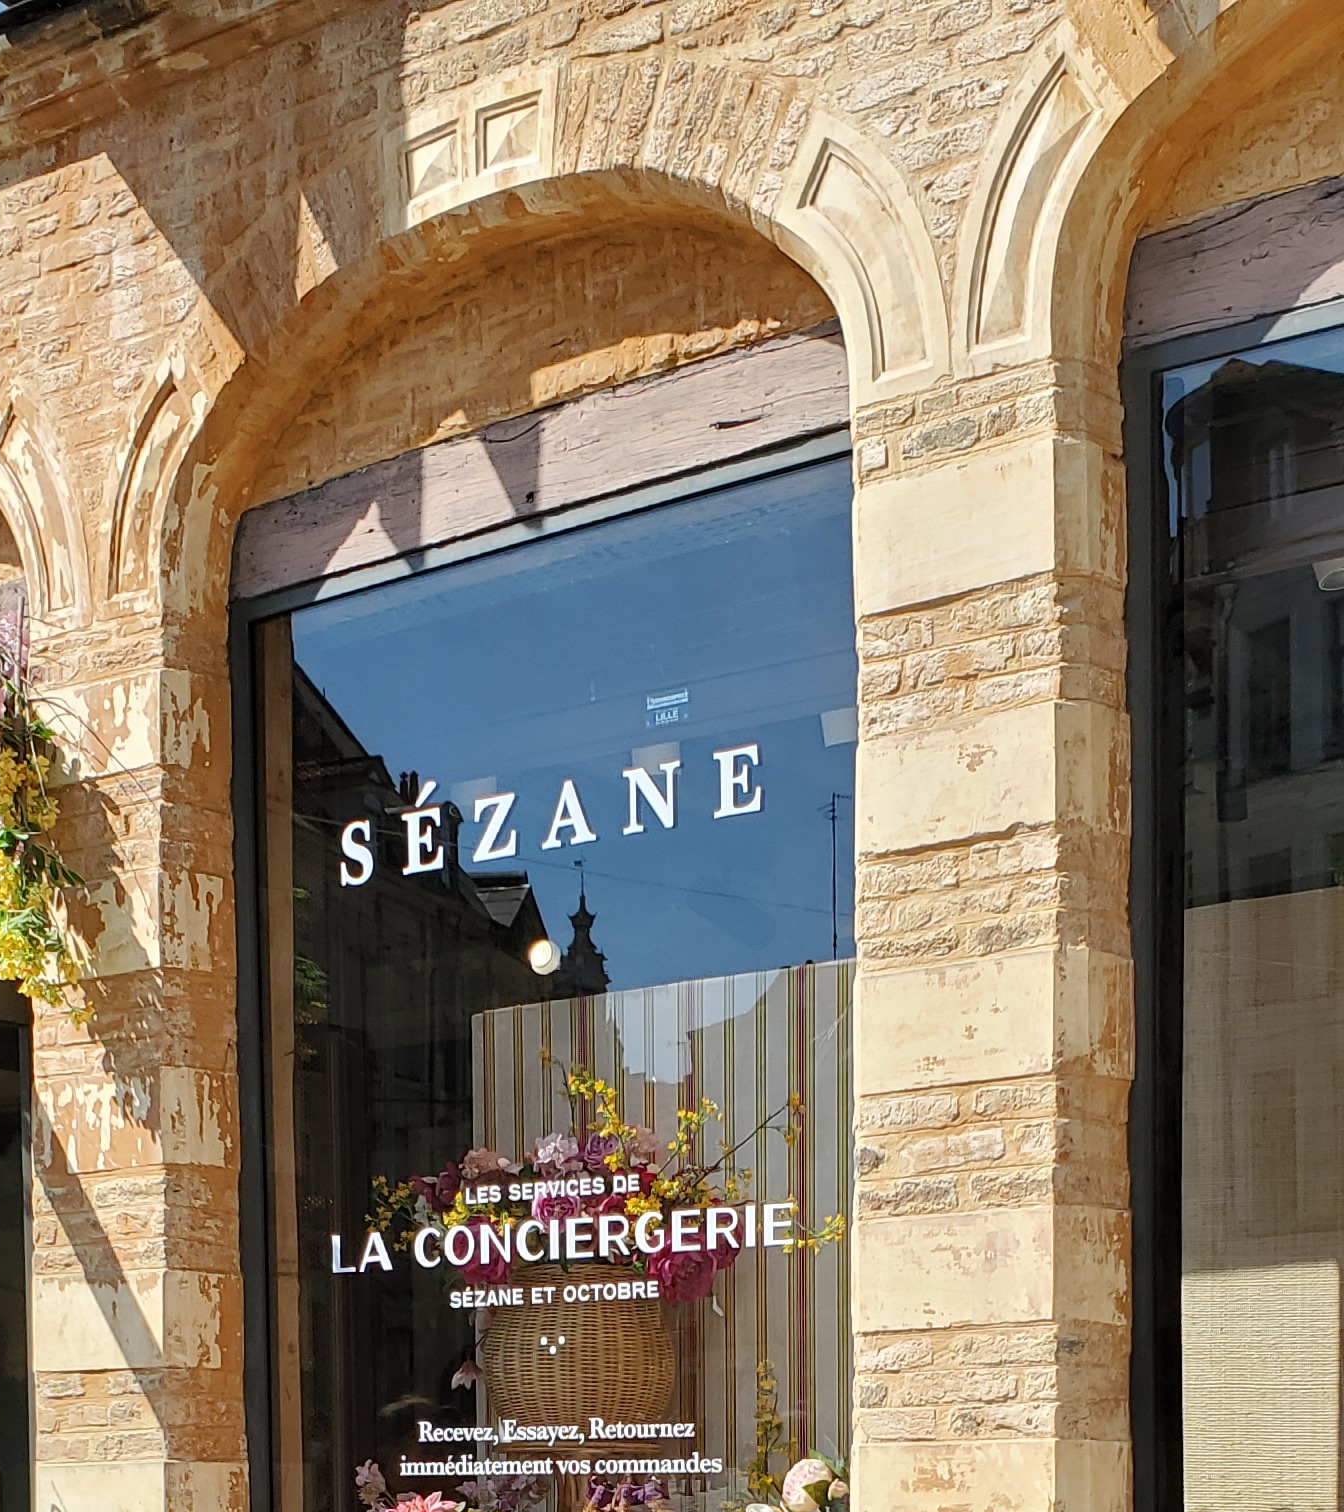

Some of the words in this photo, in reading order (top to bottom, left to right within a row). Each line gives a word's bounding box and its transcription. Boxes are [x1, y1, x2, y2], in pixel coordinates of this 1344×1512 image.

[340, 744, 762, 888] SÉZANE
[465, 1186, 501, 1205] LES
[508, 1177, 603, 1202] SERVICES
[612, 1173, 641, 1194] DE
[331, 1232, 394, 1274] LA
[413, 1202, 796, 1269] CONCIERGERIE
[449, 1286, 524, 1309] SÉZANE
[531, 1285, 556, 1304] ET
[562, 1280, 660, 1303] OCTOBRE
[418, 1420, 499, 1445] Recevez,
[503, 1419, 585, 1446] Essayez,
[588, 1417, 695, 1439] Retournez
[400, 1454, 553, 1477] immédiatement
[557, 1459, 590, 1474] vos
[595, 1452, 723, 1474] commandes
